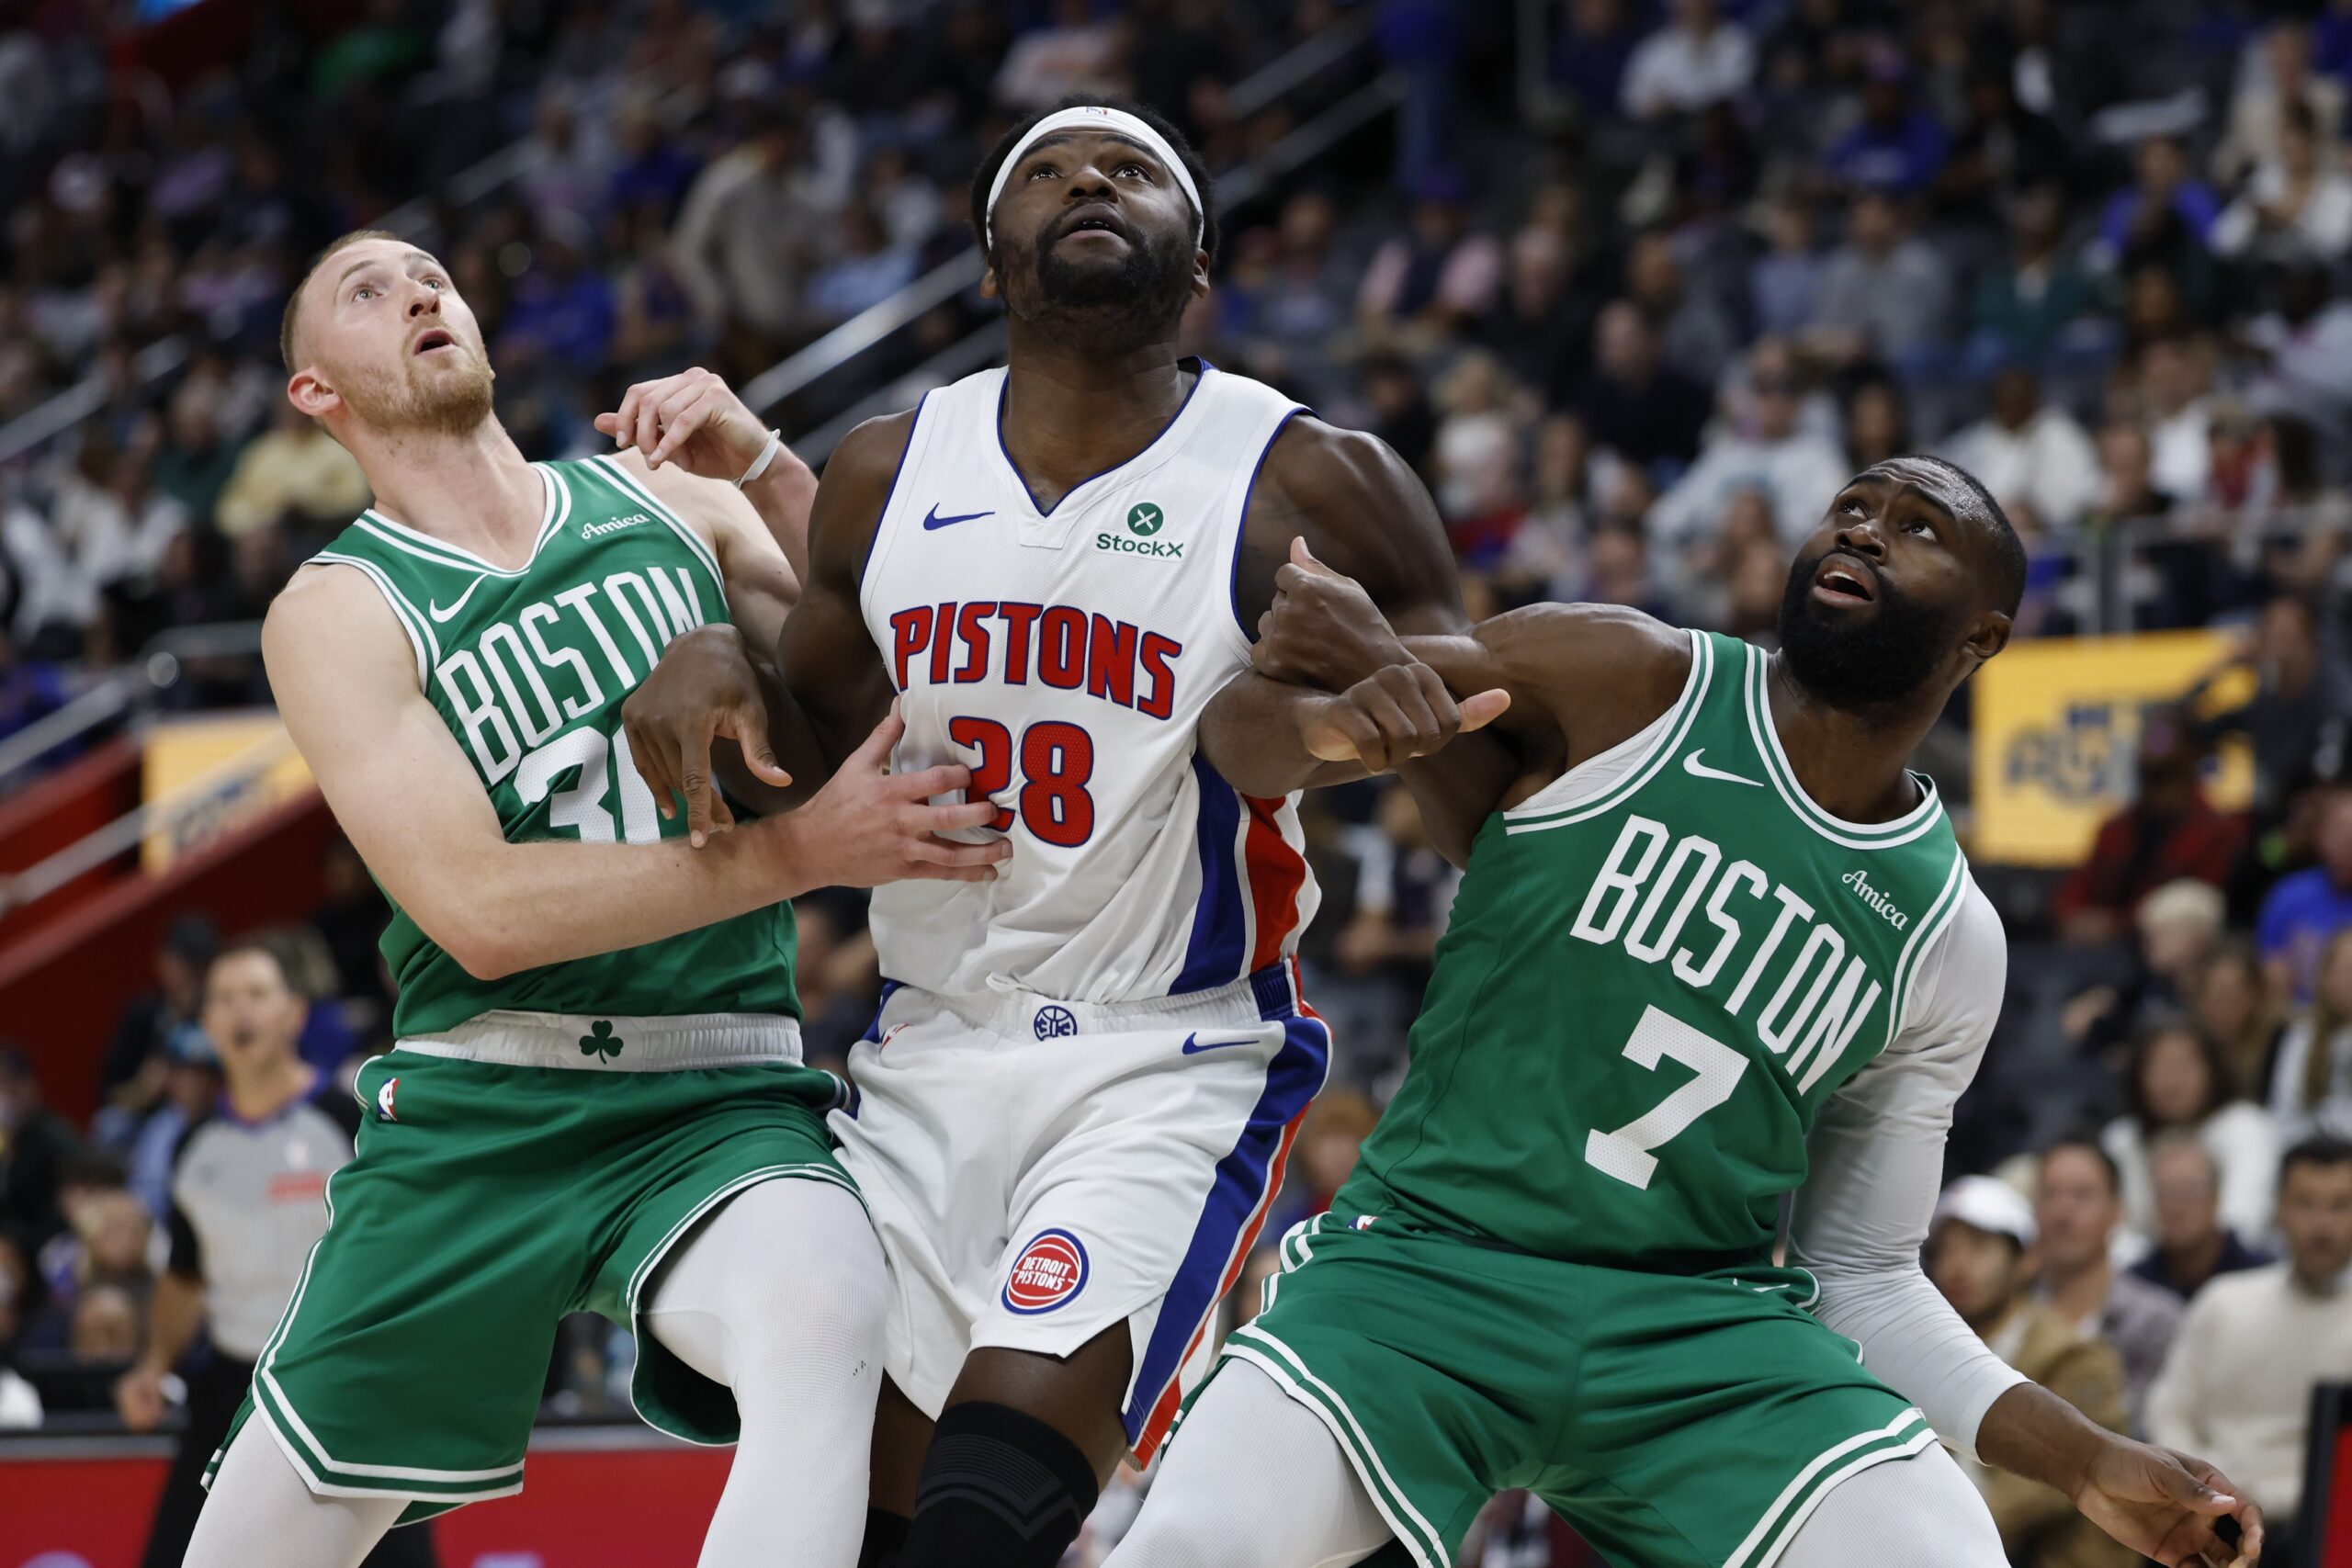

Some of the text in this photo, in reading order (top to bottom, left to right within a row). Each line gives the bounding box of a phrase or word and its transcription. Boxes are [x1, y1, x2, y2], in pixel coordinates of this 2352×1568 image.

[581, 513, 650, 539] Amica
[1096, 533, 1184, 558] StockX
[435, 567, 706, 787] BOSTON
[889, 601, 1182, 721] PISTONS
[948, 715, 1095, 849] 28
[1841, 870, 1909, 931] Amica
[1569, 814, 1883, 1098] BOSTON
[1584, 1004, 1751, 1190] 7
[1014, 1269, 1066, 1292] PISTONS
[1022, 1256, 1072, 1278] DETROIT
